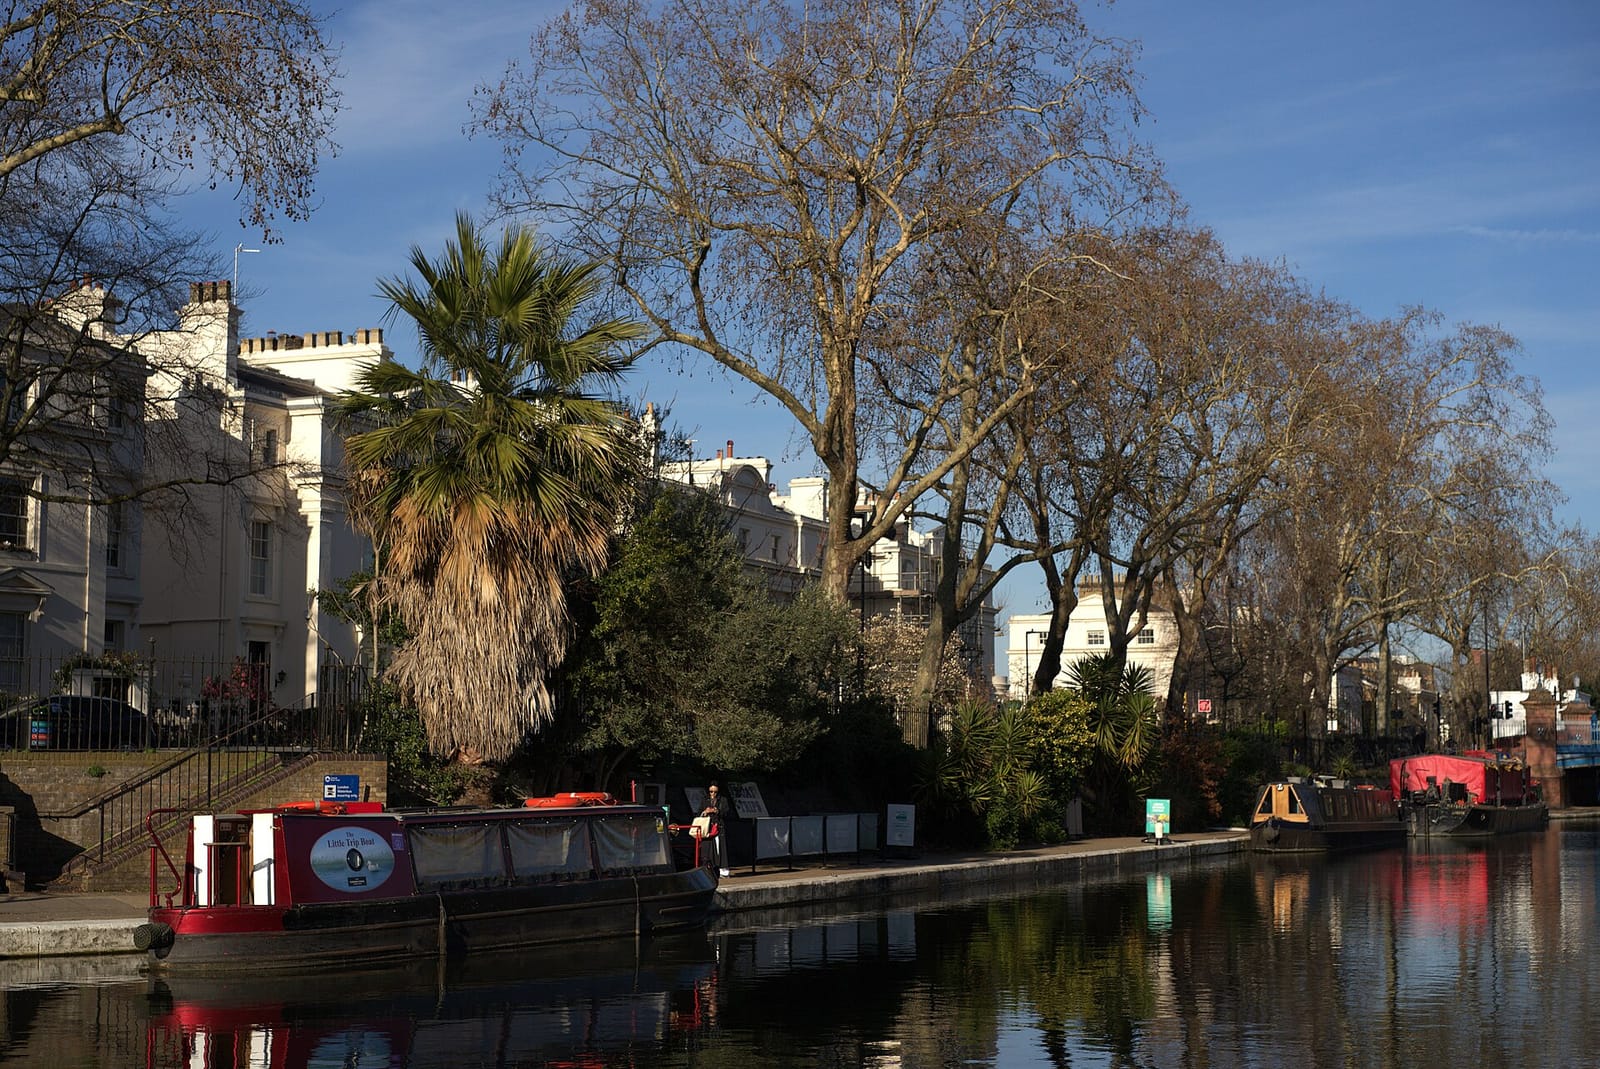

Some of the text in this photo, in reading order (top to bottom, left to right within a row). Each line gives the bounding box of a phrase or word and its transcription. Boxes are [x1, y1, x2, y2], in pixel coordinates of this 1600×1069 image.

[327, 838, 375, 848] Little Trip Boat
